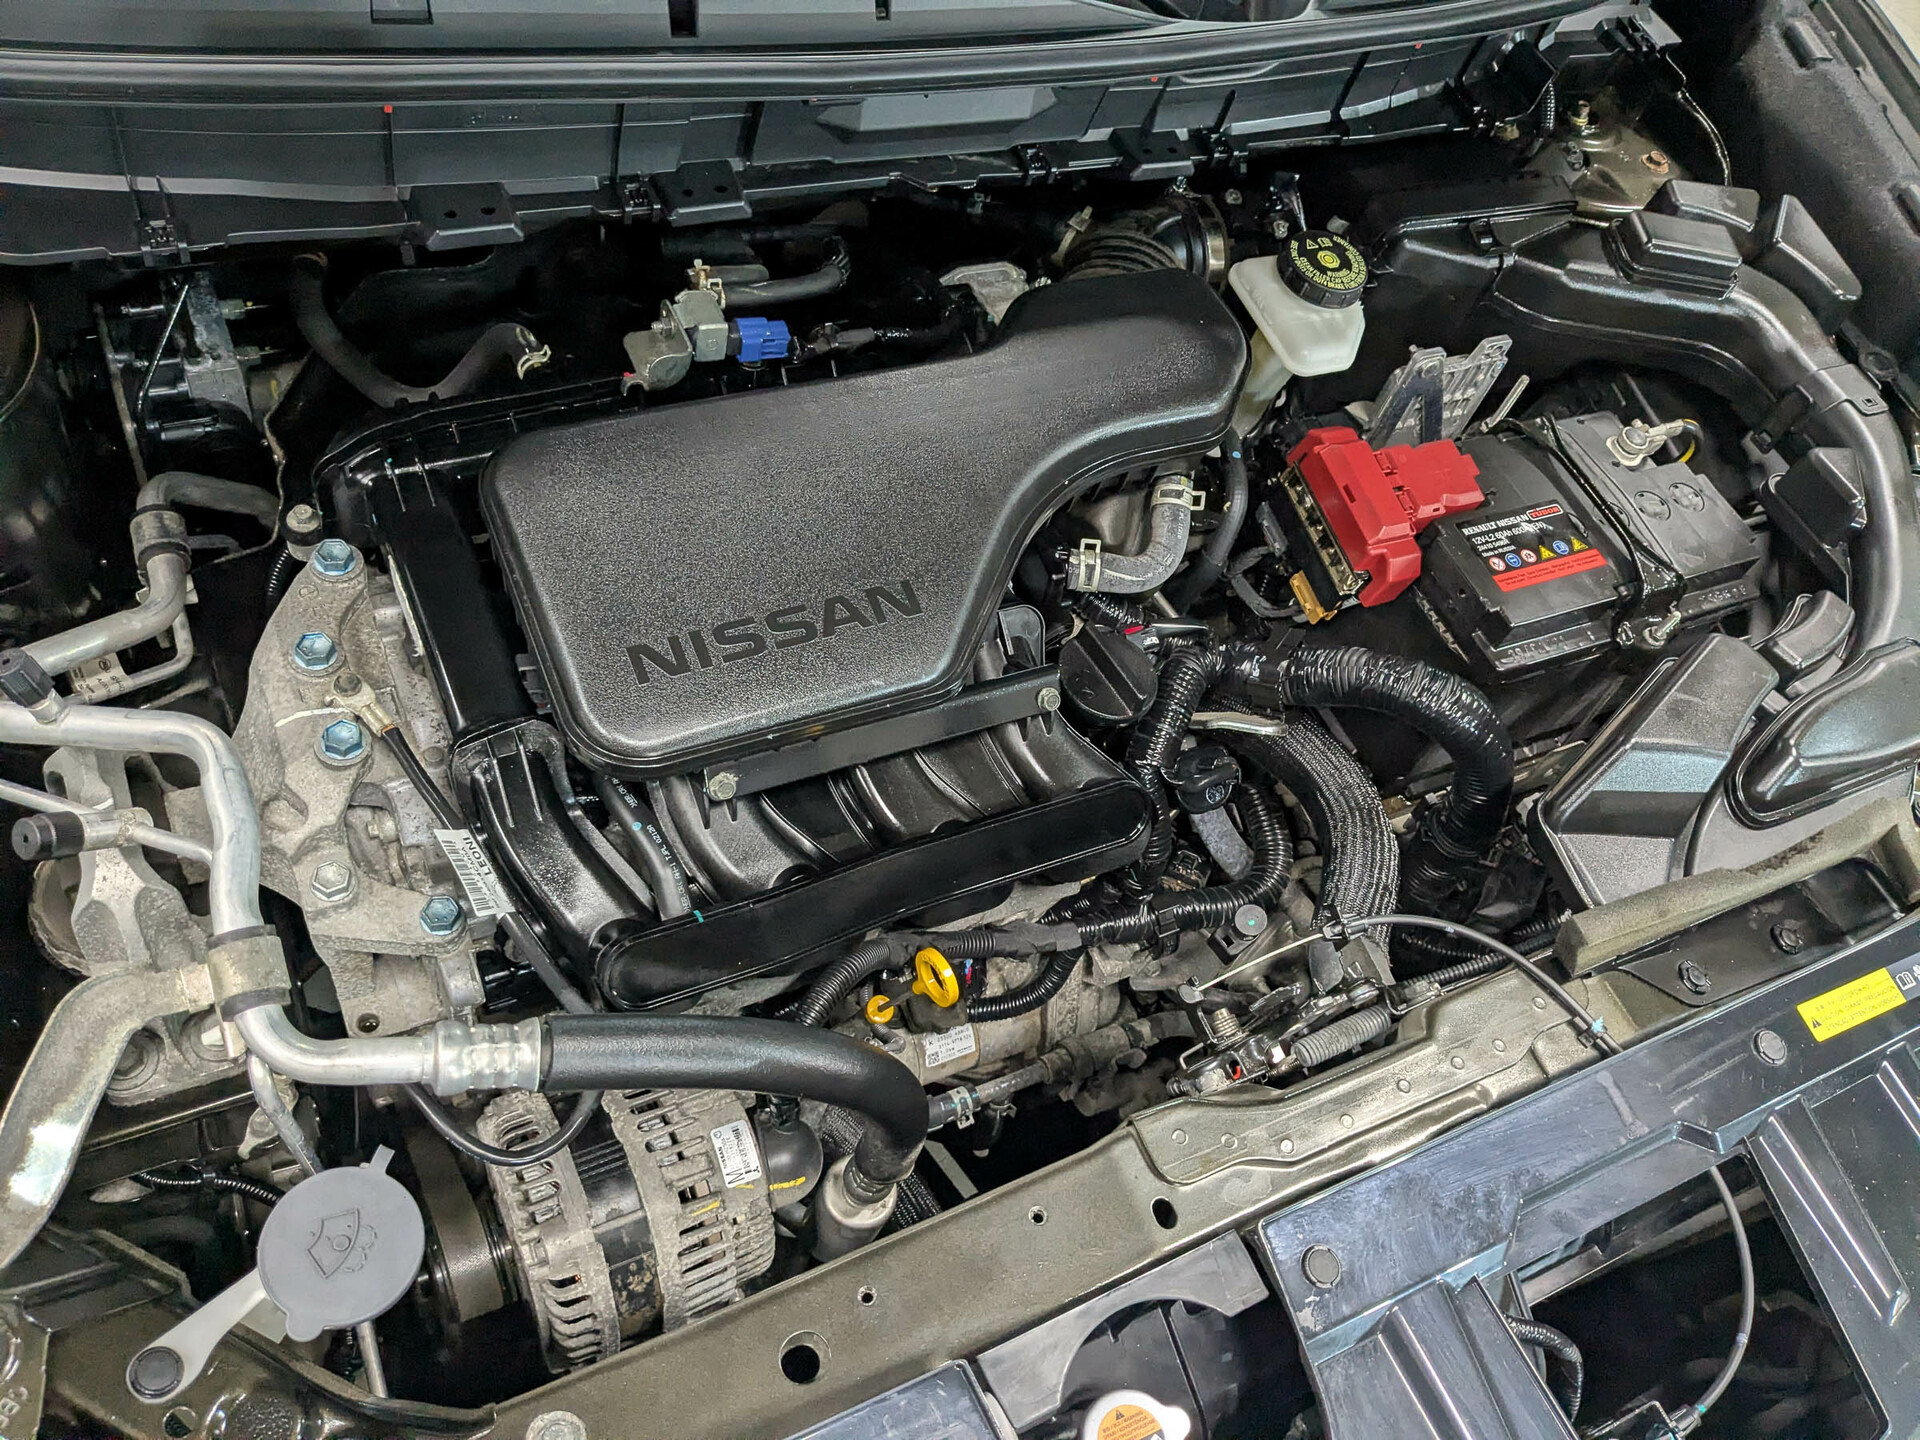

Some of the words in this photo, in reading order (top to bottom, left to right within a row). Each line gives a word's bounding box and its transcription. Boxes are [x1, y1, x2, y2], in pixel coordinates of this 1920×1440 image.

[1462, 522, 1497, 536] RENAULT
[1496, 514, 1529, 527] NISSAN
[1496, 530, 1513, 540] 60Ah
[625, 580, 923, 685] NISSAN
[463, 837, 492, 875] LEONI
[718, 1146, 727, 1169] NISSAN
